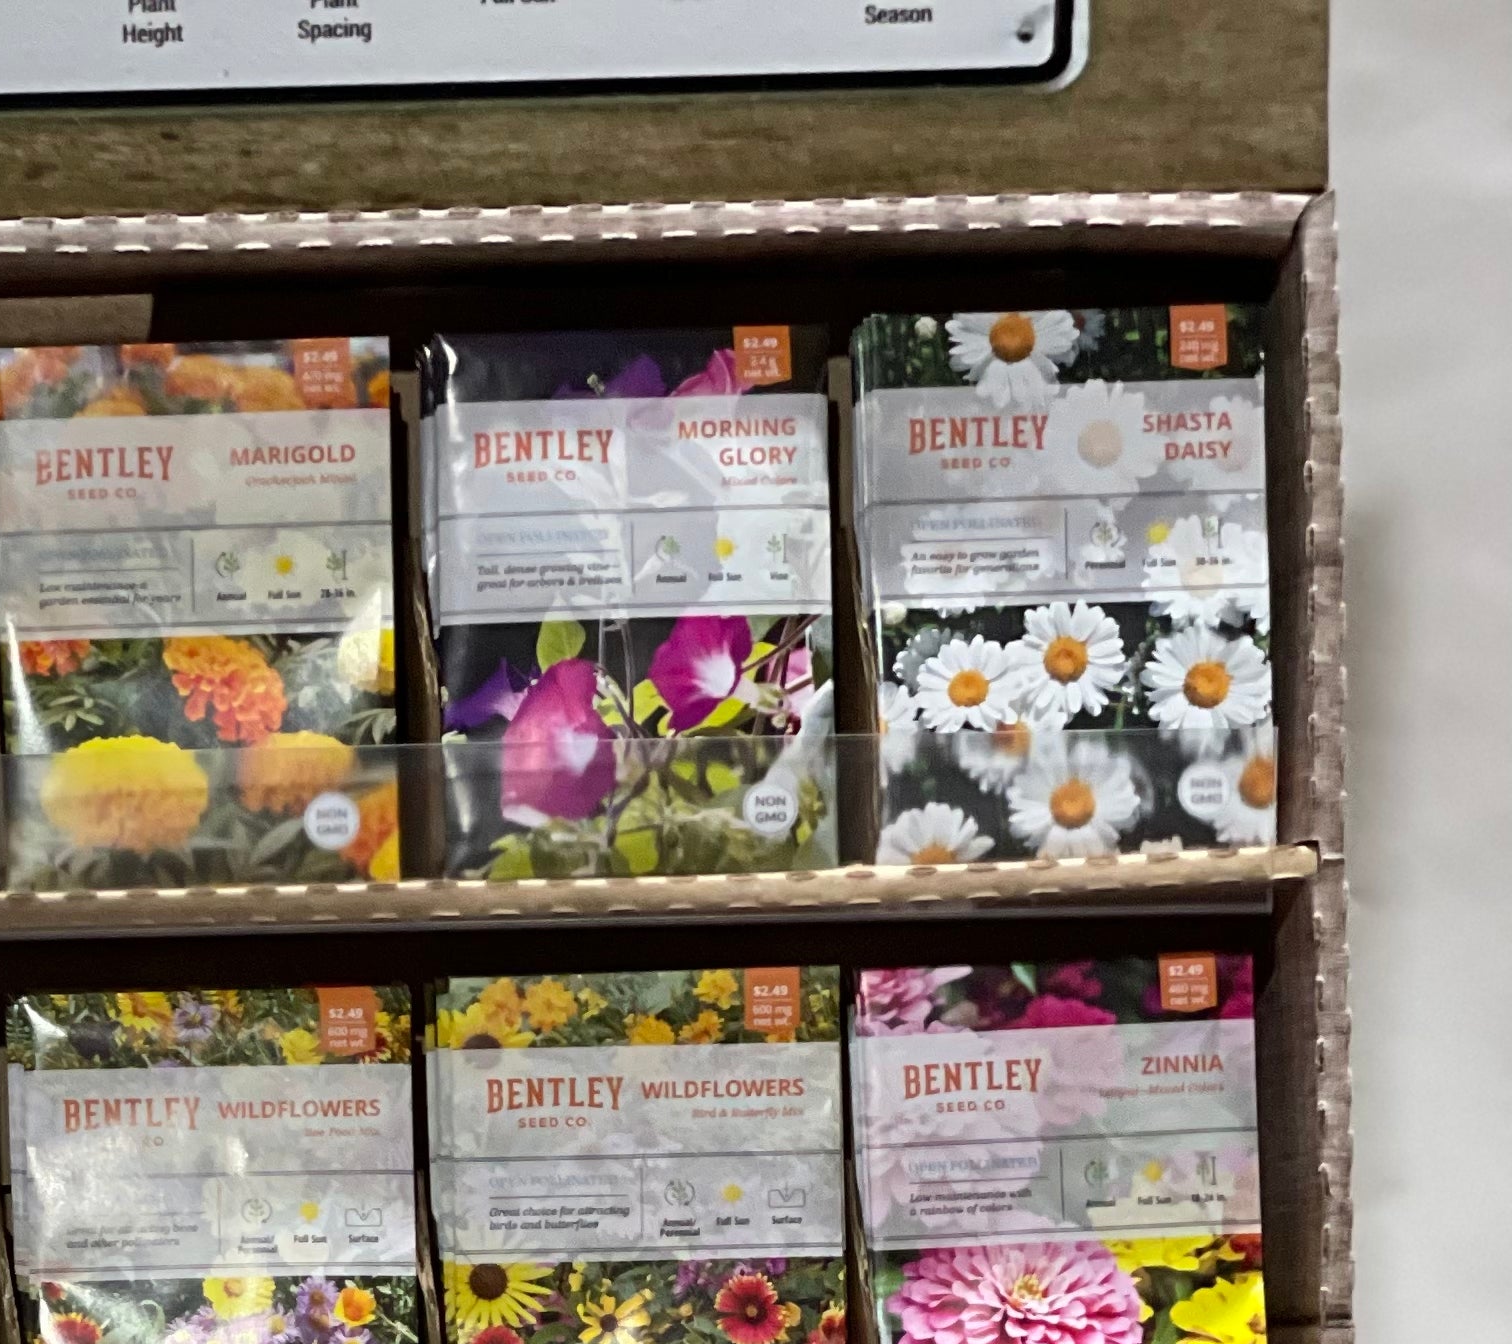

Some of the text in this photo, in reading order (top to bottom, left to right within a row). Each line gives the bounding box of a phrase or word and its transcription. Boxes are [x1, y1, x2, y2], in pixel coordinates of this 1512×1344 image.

[865, 5, 932, 24] Season
[123, 23, 183, 47] Height
[298, 20, 372, 43] Spacing
[1180, 321, 1214, 333] $2.49
[743, 338, 777, 348] $2.49
[678, 418, 796, 439] MORNING
[1144, 411, 1231, 433] SHASTA
[909, 415, 1048, 455] BENTLEY
[231, 444, 355, 465] MARIGOLD
[473, 428, 613, 468] BENTLEY
[719, 446, 797, 466] GLORY
[1165, 441, 1232, 461] DAISY
[37, 446, 173, 485] BENTLEY
[1169, 964, 1203, 976] $2.49
[754, 985, 788, 996] $2.49
[329, 1008, 363, 1019] $2.49
[1142, 1054, 1224, 1075] ZINNIA
[641, 1078, 804, 1099] WILDFLOWERS
[904, 1058, 1041, 1099] BENTLEY
[487, 1077, 623, 1113] BENTLEY
[63, 1097, 199, 1133] BENTLEY
[218, 1099, 380, 1119] WILDFLOWERS
[518, 1117, 558, 1128] SEED
